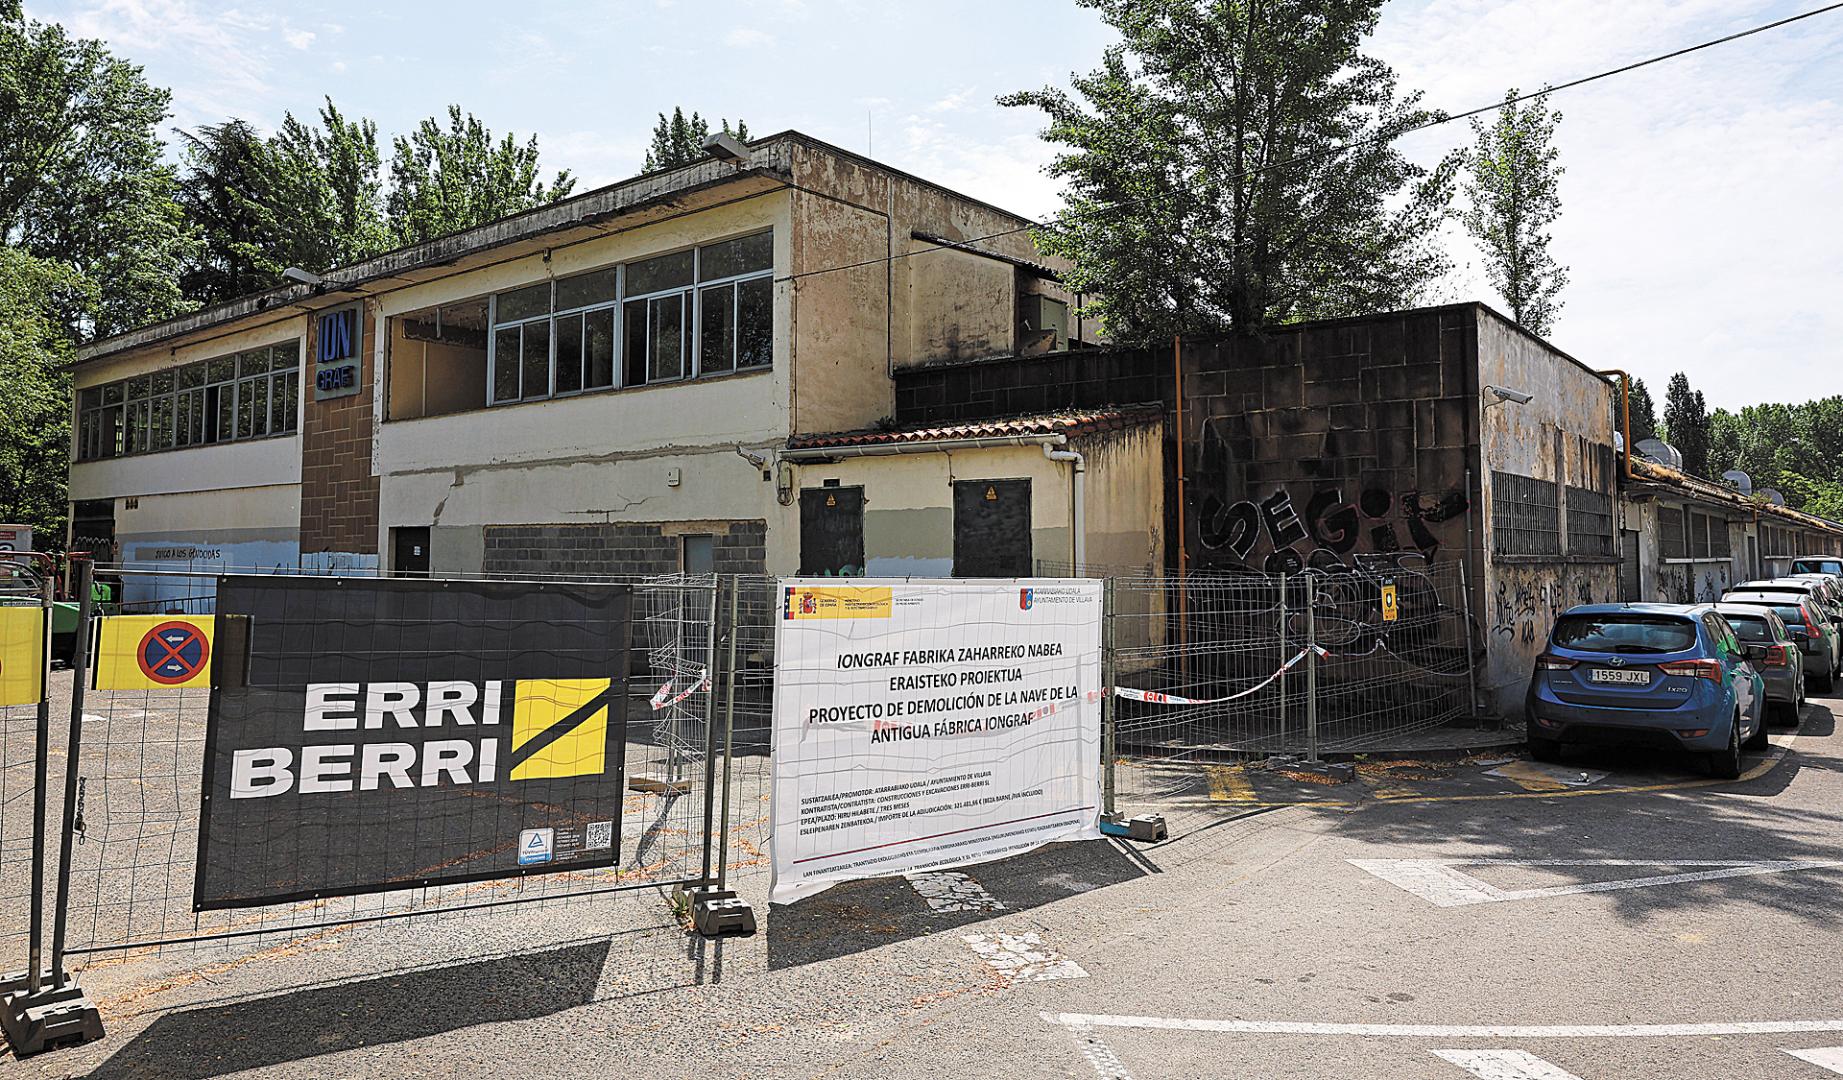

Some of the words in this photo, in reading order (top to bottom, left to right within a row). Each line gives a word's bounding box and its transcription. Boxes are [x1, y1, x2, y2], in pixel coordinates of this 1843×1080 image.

[318, 309, 355, 363] ION
[177, 549, 187, 558] LOS
[838, 652, 900, 668] IONGRAF
[903, 649, 955, 665] FABRIKA
[958, 644, 1025, 662] ZAHARREKO
[1028, 643, 1062, 658] NABEA
[890, 673, 957, 691] ERAISTEKO
[960, 668, 1022, 686] PROIEKTUA
[1596, 670, 1622, 680] 1559
[1626, 672, 1648, 682] JXL
[303, 680, 502, 732] ERRI
[809, 704, 883, 724] PROYECTO
[887, 702, 904, 716] DE
[907, 692, 984, 715] DEMOLICIÓN
[988, 692, 1002, 706] DE
[1004, 691, 1016, 705] LA
[1020, 688, 1048, 704] NAVE
[1050, 687, 1064, 700] DE
[1066, 686, 1078, 699] LA
[871, 724, 930, 744] ANTIGUA
[934, 718, 982, 736] FÁBRICA
[985, 712, 1034, 731] IONGRAF
[230, 737, 498, 800] BERRI
[930, 774, 966, 786] AYUNTAMIENTO
[974, 770, 992, 778] VILLAVA
[838, 812, 851, 820] HIRU
